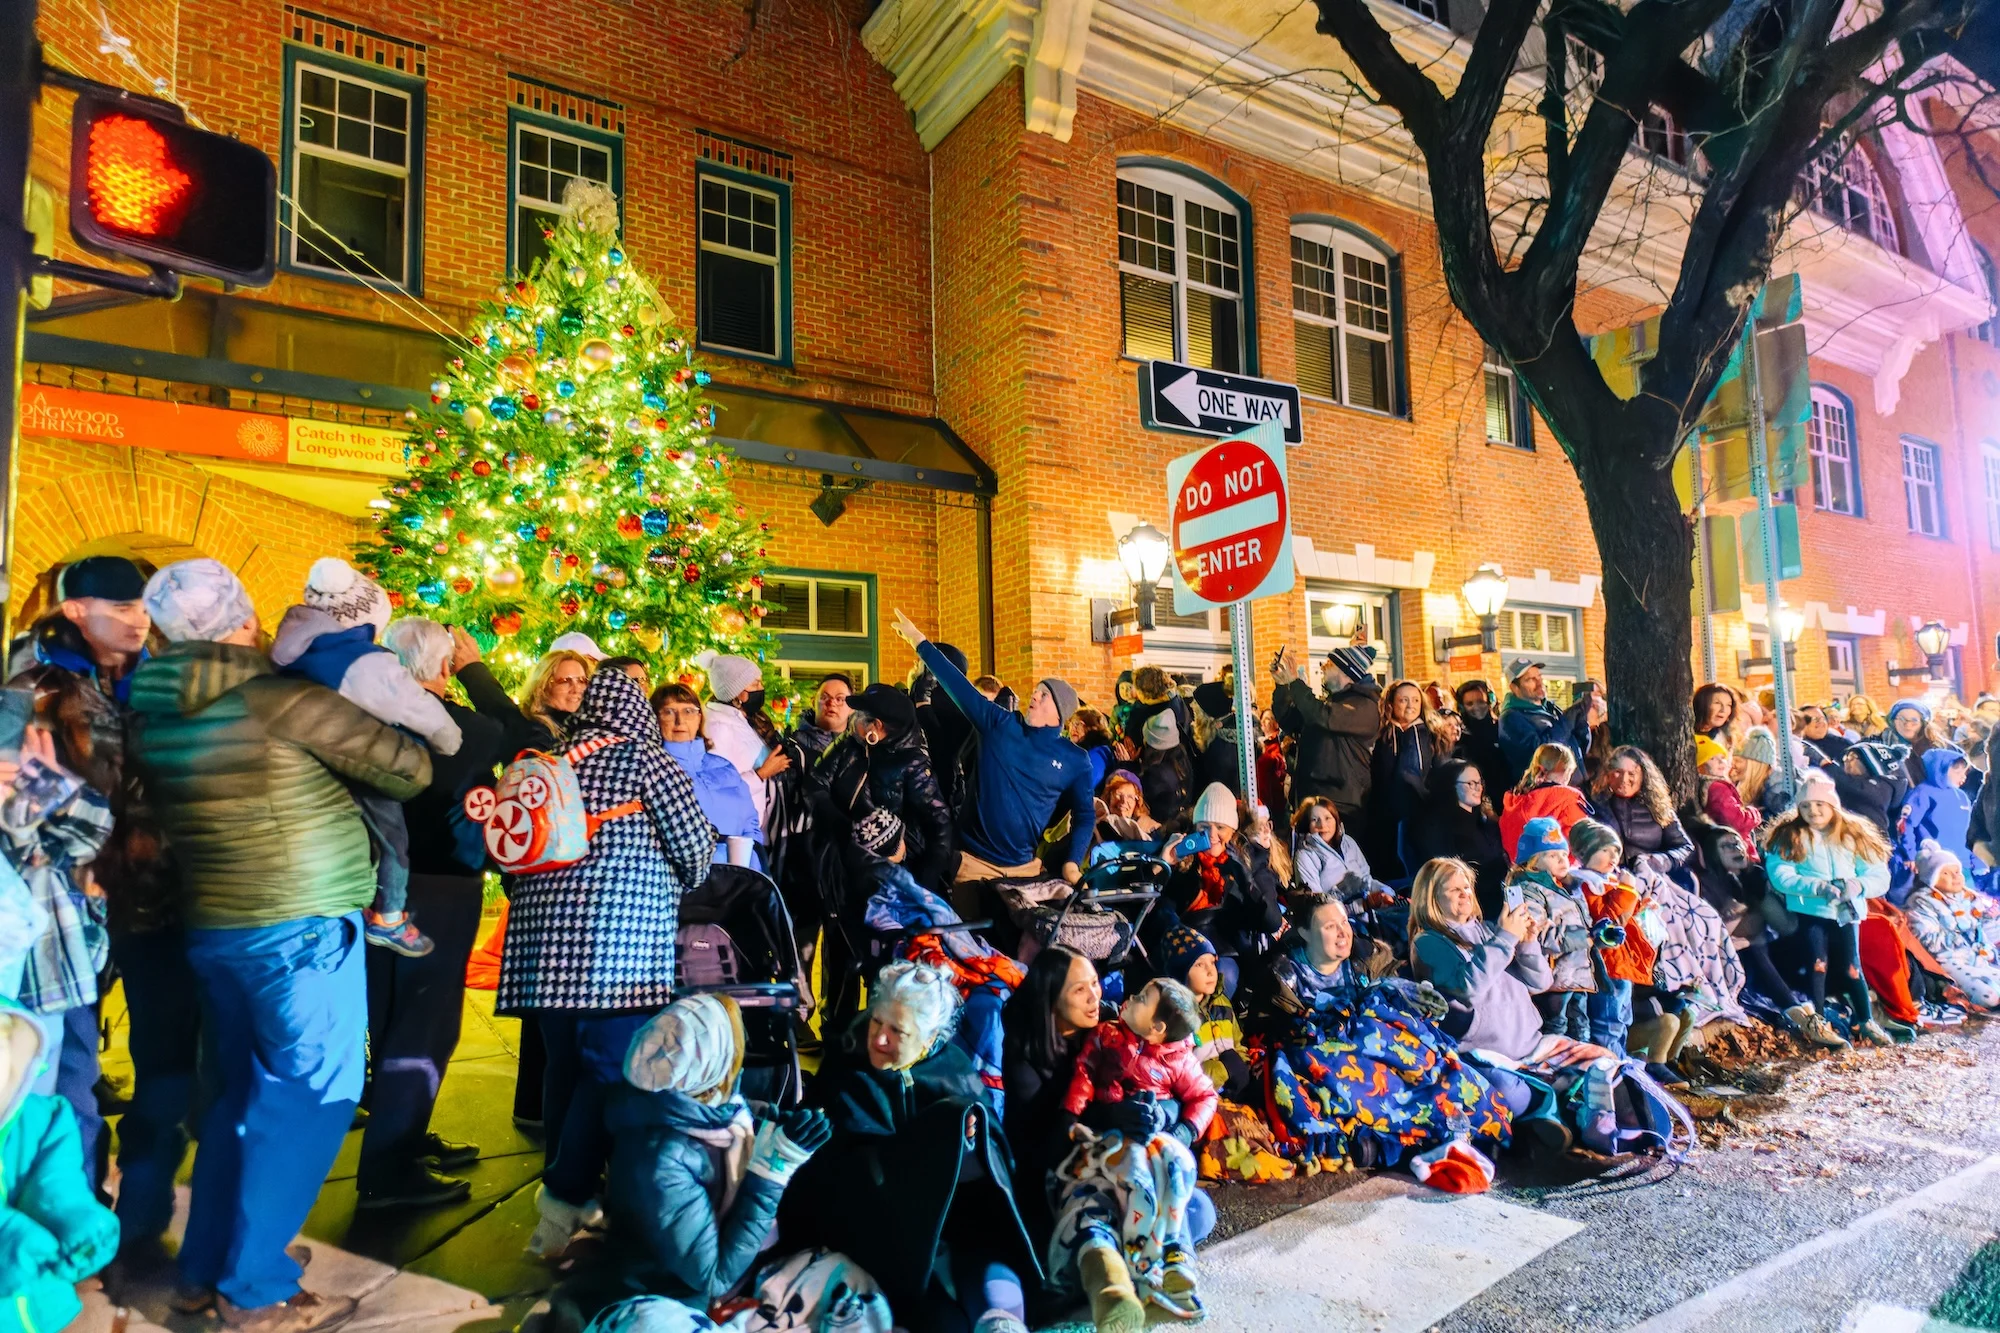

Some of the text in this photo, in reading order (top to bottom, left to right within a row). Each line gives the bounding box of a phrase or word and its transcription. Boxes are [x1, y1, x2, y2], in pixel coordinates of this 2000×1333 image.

[33, 391, 47, 405] A
[1198, 389, 1283, 420] ONE WAY
[20, 402, 119, 427] ONGWOOD
[20, 415, 125, 439] CHRISTMAS
[296, 425, 345, 442] Catch
[350, 432, 376, 446] the
[296, 440, 385, 462] Longwood
[1186, 460, 1265, 511] DO NOT
[1197, 538, 1262, 577] ENTER
